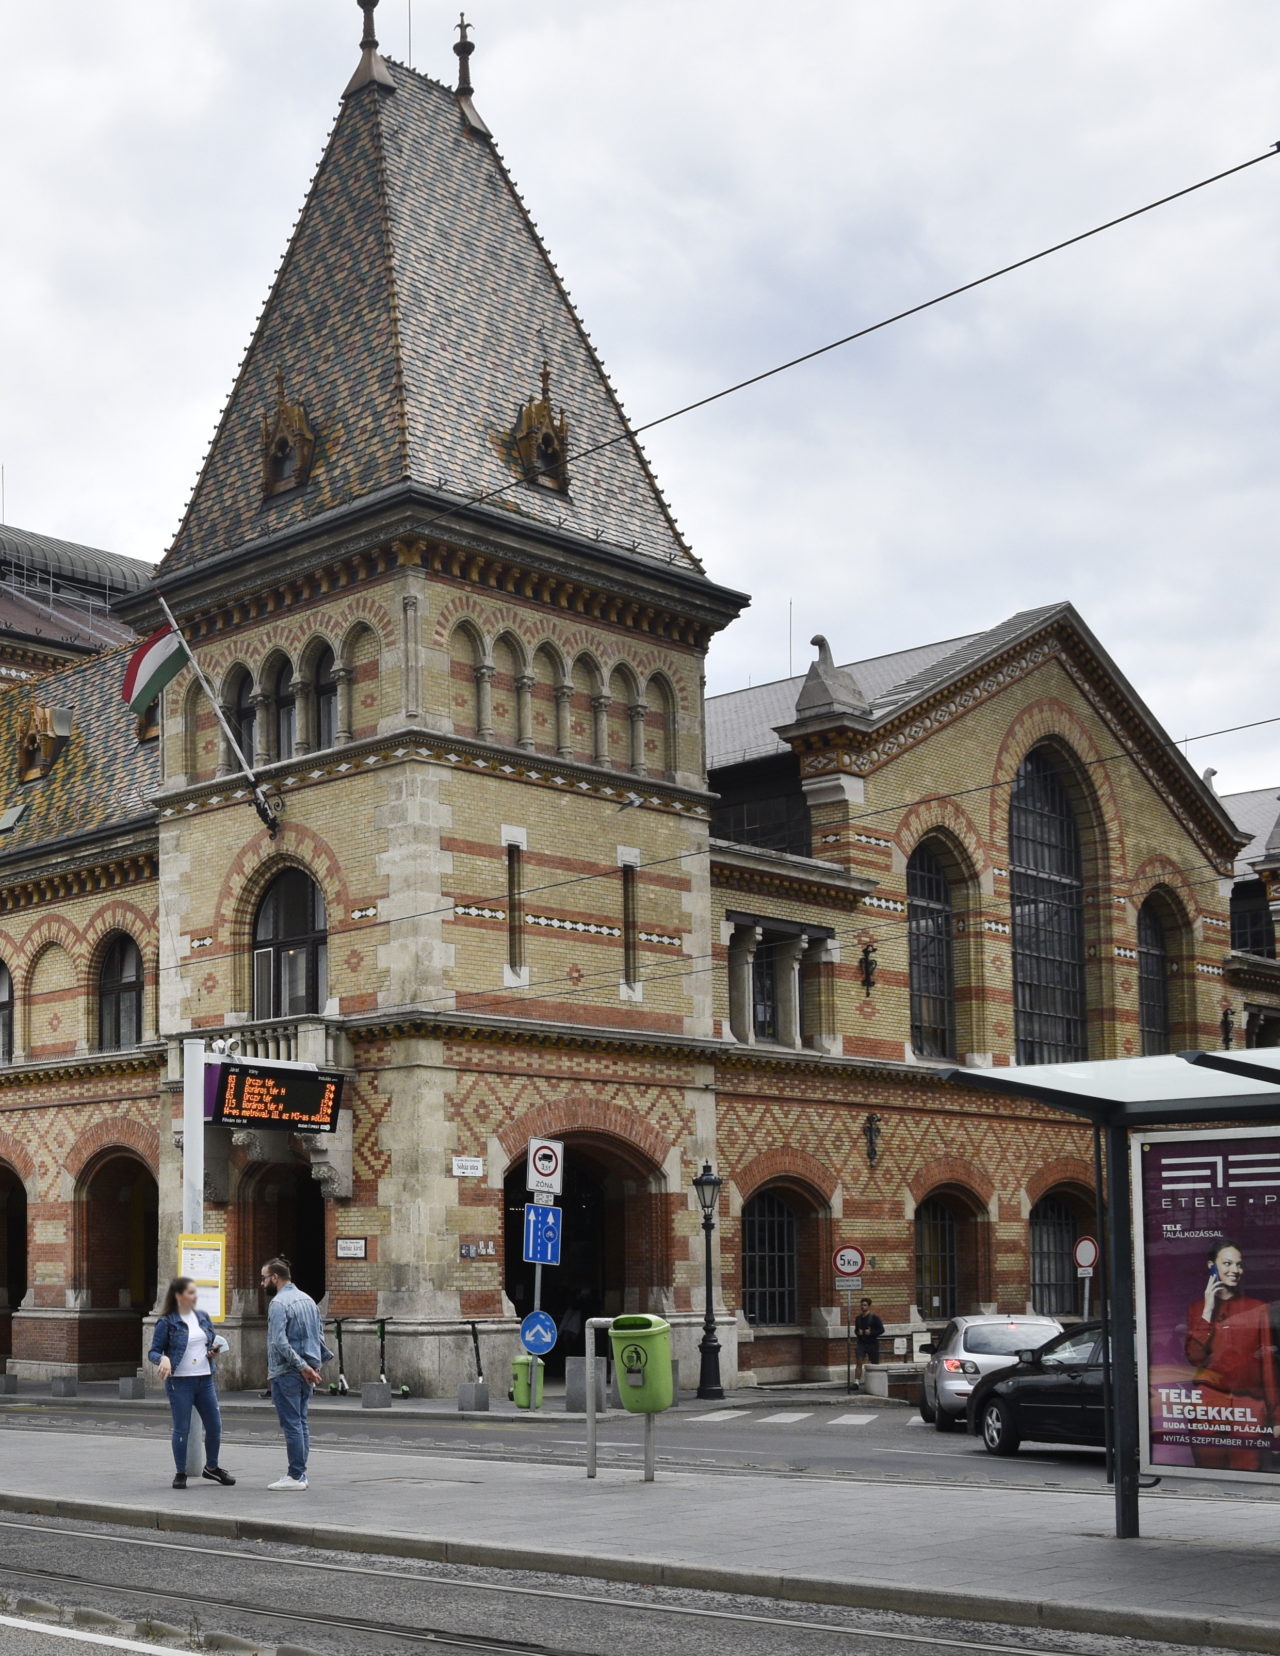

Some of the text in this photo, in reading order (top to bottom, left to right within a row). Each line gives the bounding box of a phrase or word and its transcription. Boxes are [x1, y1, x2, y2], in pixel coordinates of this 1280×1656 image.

[246, 1076, 263, 1086] Orczy
[265, 1078, 275, 1087] tér
[244, 1084, 267, 1094] Boráros
[270, 1086, 279, 1095] tér
[243, 1092, 260, 1102] Orczy
[263, 1094, 272, 1102] tér
[225, 1099, 236, 1108] 115
[242, 1100, 265, 1110] Boráros
[267, 1102, 277, 1111] tér
[535, 1181, 554, 1189] ZÓNA
[1161, 1196, 1237, 1209] ETELE
[1162, 1230, 1224, 1238] TALÁLKOZÁSSAL
[840, 1254, 846, 1266] 5
[1158, 1388, 1202, 1404] TELE
[1162, 1405, 1258, 1422] LEGEKKEL
[1188, 1422, 1231, 1432] LEGÚJABB
[1234, 1424, 1273, 1434] PLÁZÁJA
[1163, 1435, 1271, 1448] NYITÁS SZEPTEMBER 17-ÉN!
